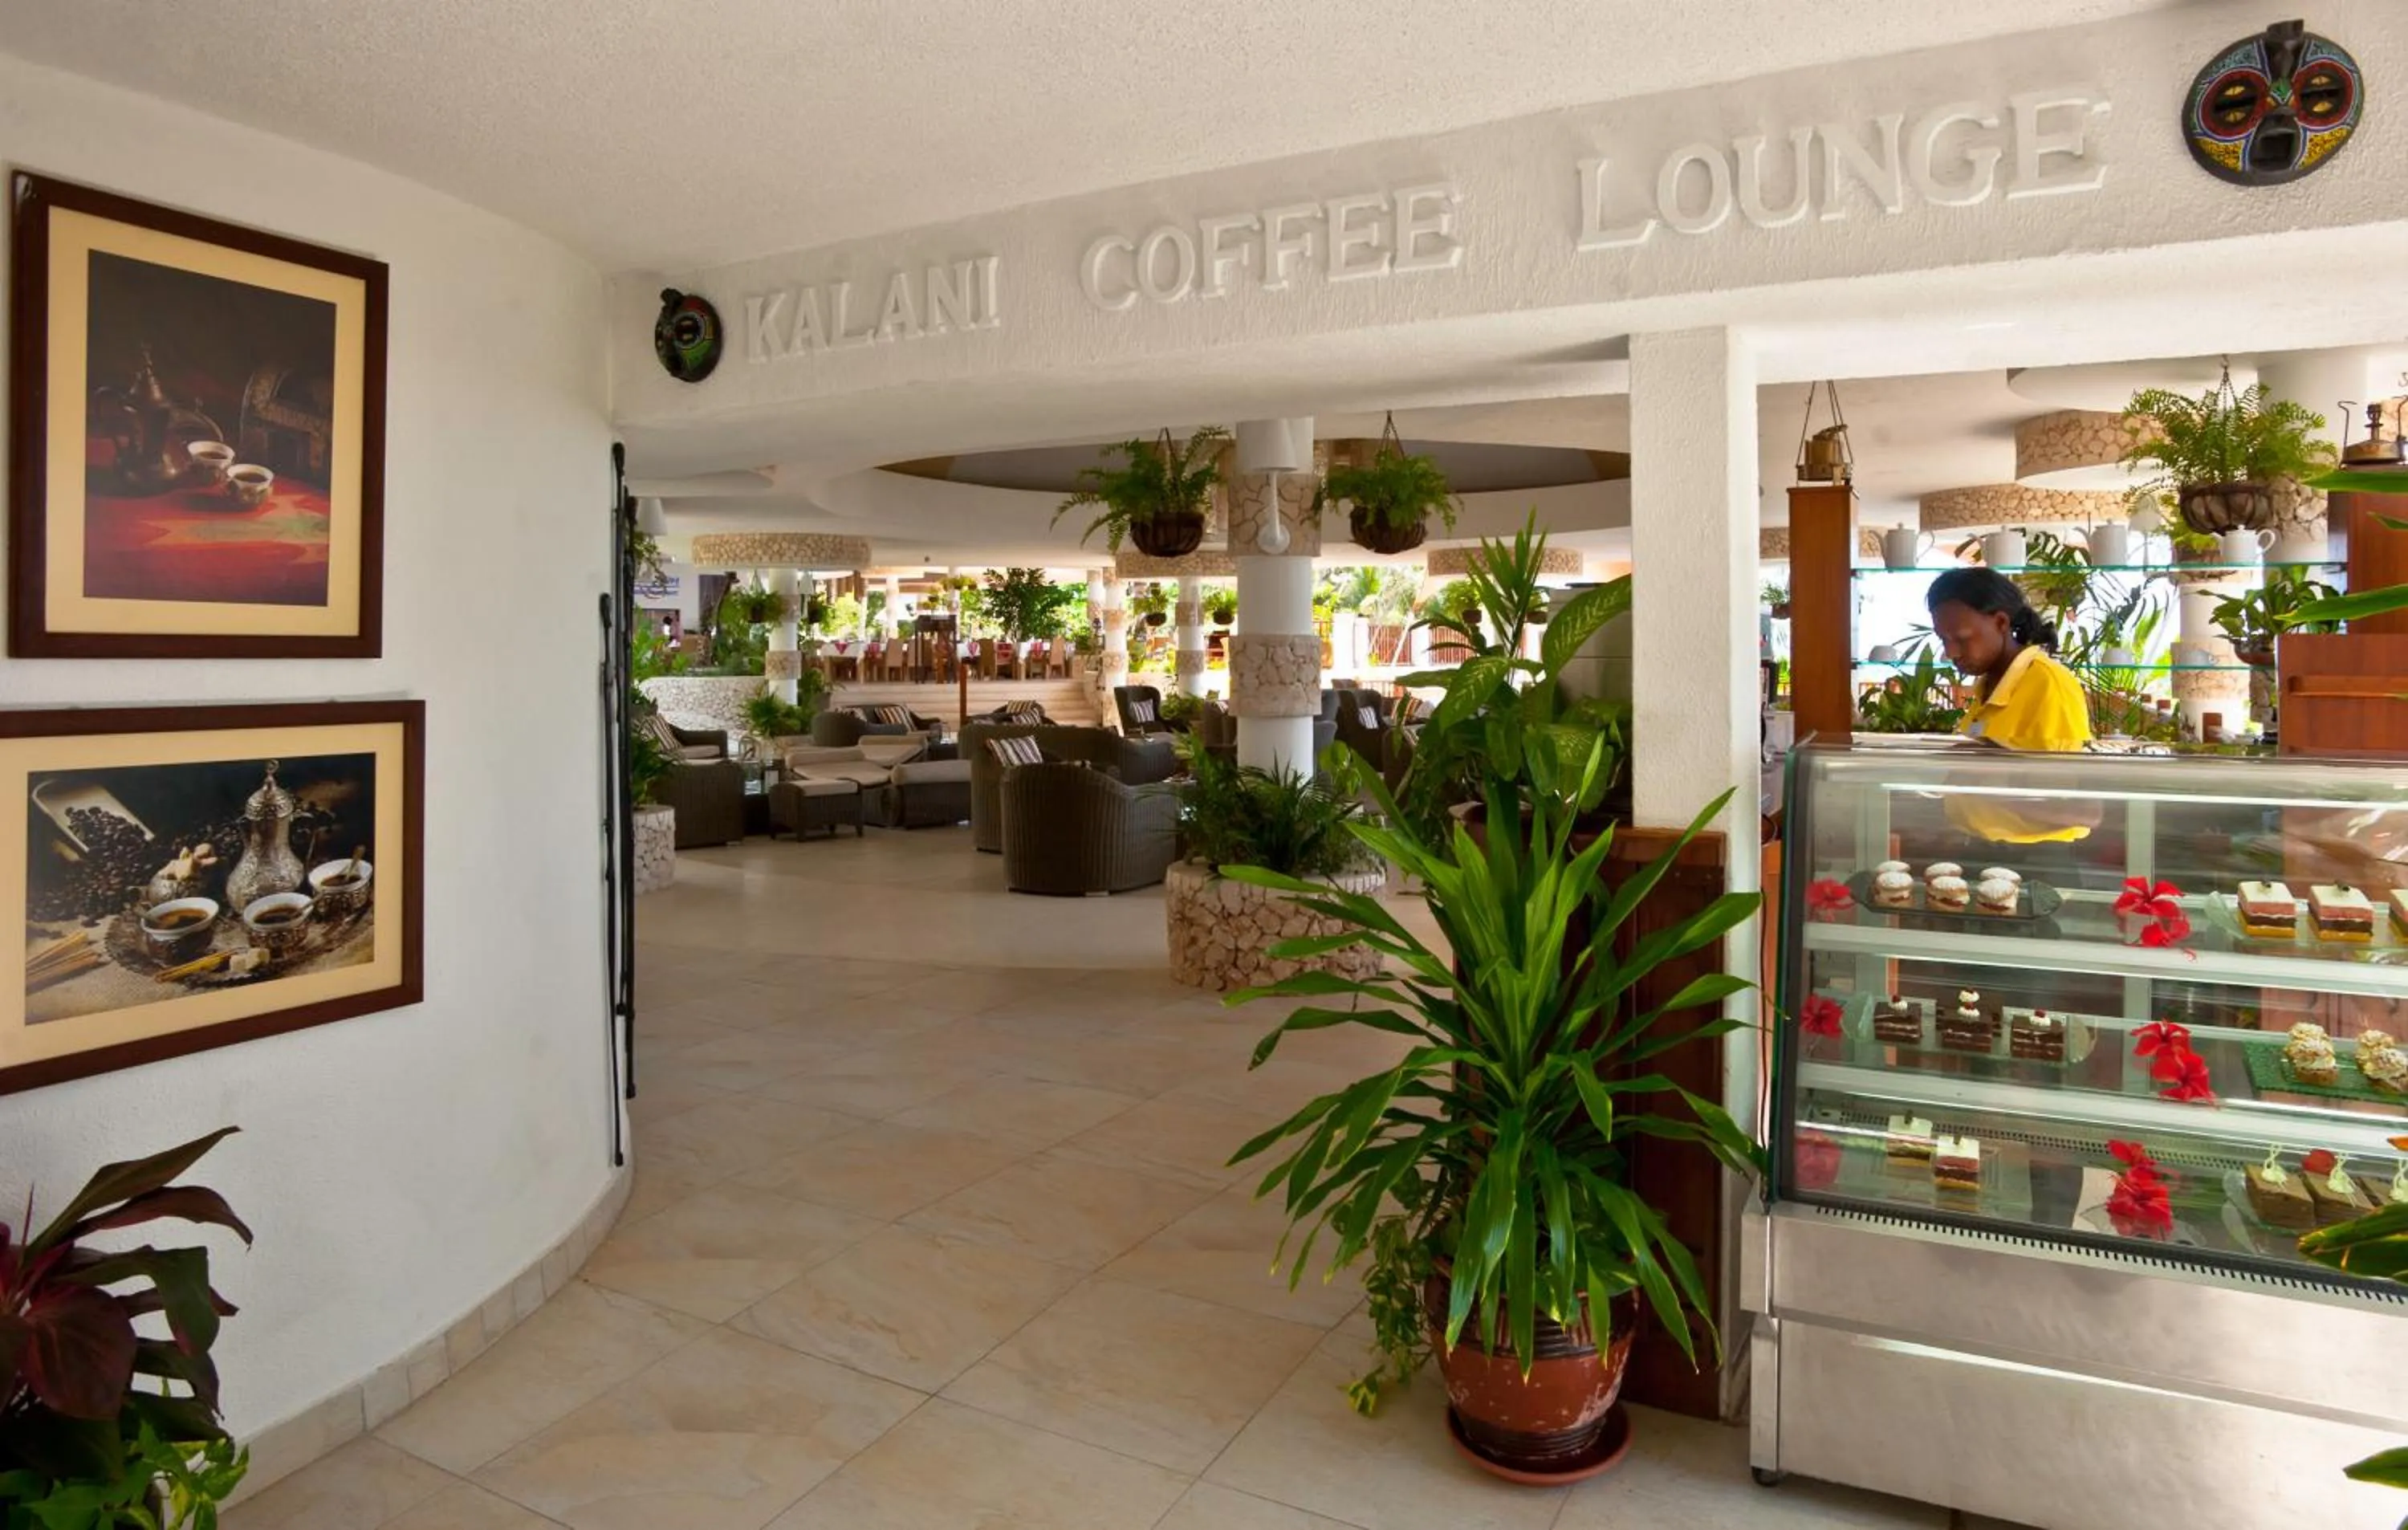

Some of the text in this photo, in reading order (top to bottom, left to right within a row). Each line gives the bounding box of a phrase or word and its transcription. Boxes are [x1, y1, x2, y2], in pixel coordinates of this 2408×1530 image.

[745, 91, 2112, 364] KALANI COFFEE LOUNGE
